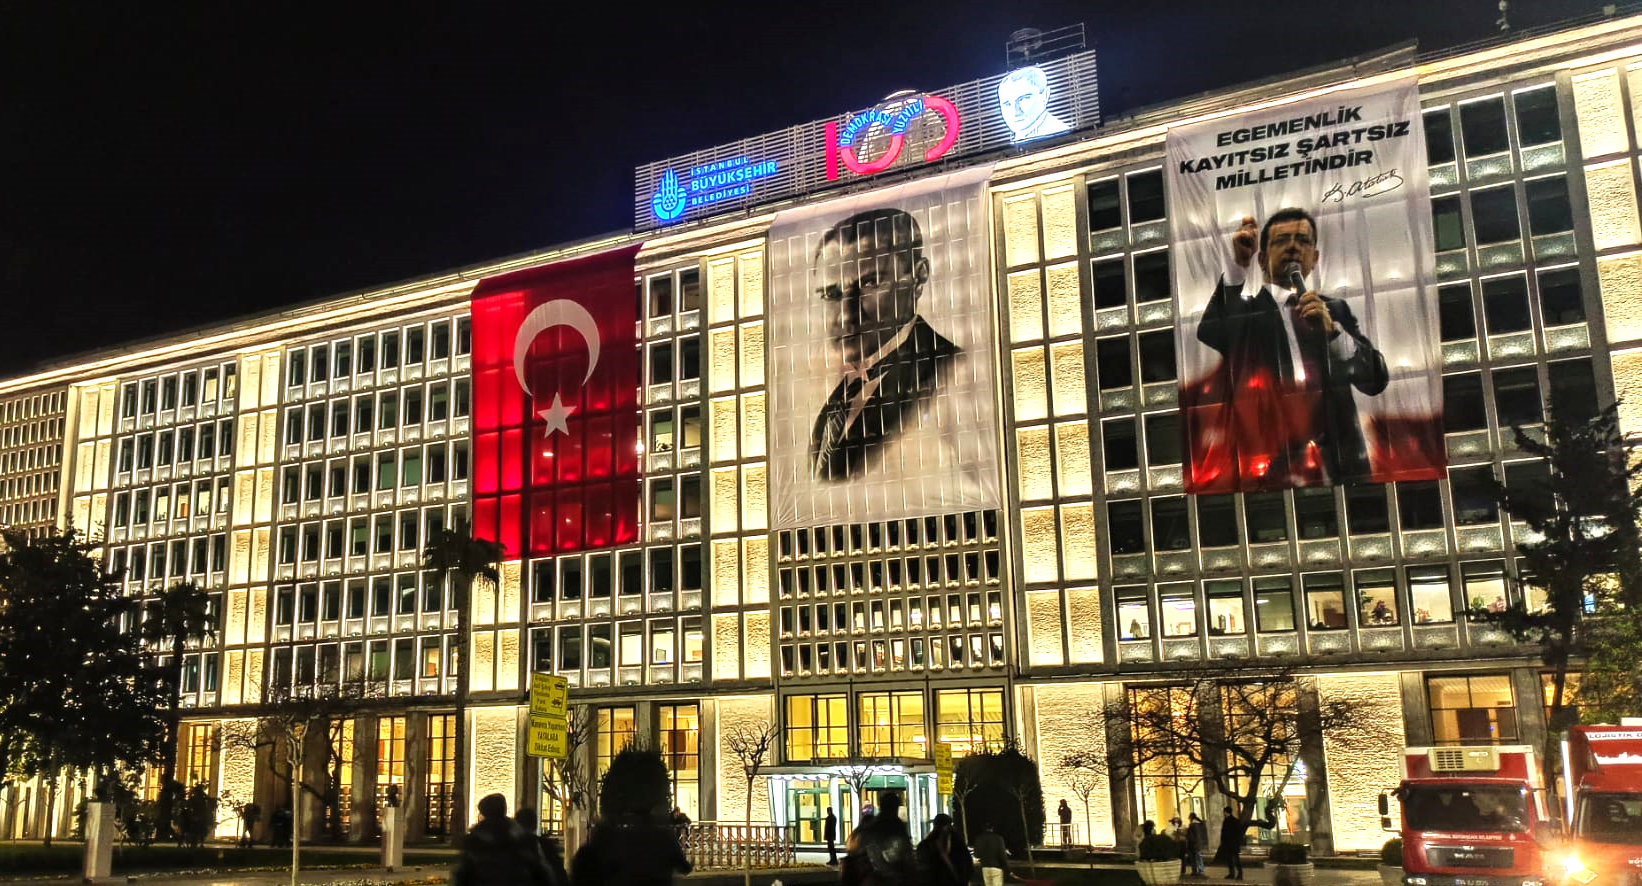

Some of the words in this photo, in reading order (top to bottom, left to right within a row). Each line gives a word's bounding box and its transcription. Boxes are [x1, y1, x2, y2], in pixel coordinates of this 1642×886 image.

[1217, 106, 1362, 147] EGEMENLİK
[1180, 143, 1290, 174] KAYITSIZ
[1297, 121, 1411, 158] ŞARTSIZ
[691, 156, 749, 176] İSTANBUL
[691, 161, 776, 191] BÜYÜKŞEHİR
[1216, 149, 1373, 190] MİLLETİNDİR
[692, 184, 750, 205] BELEDİYESİ
